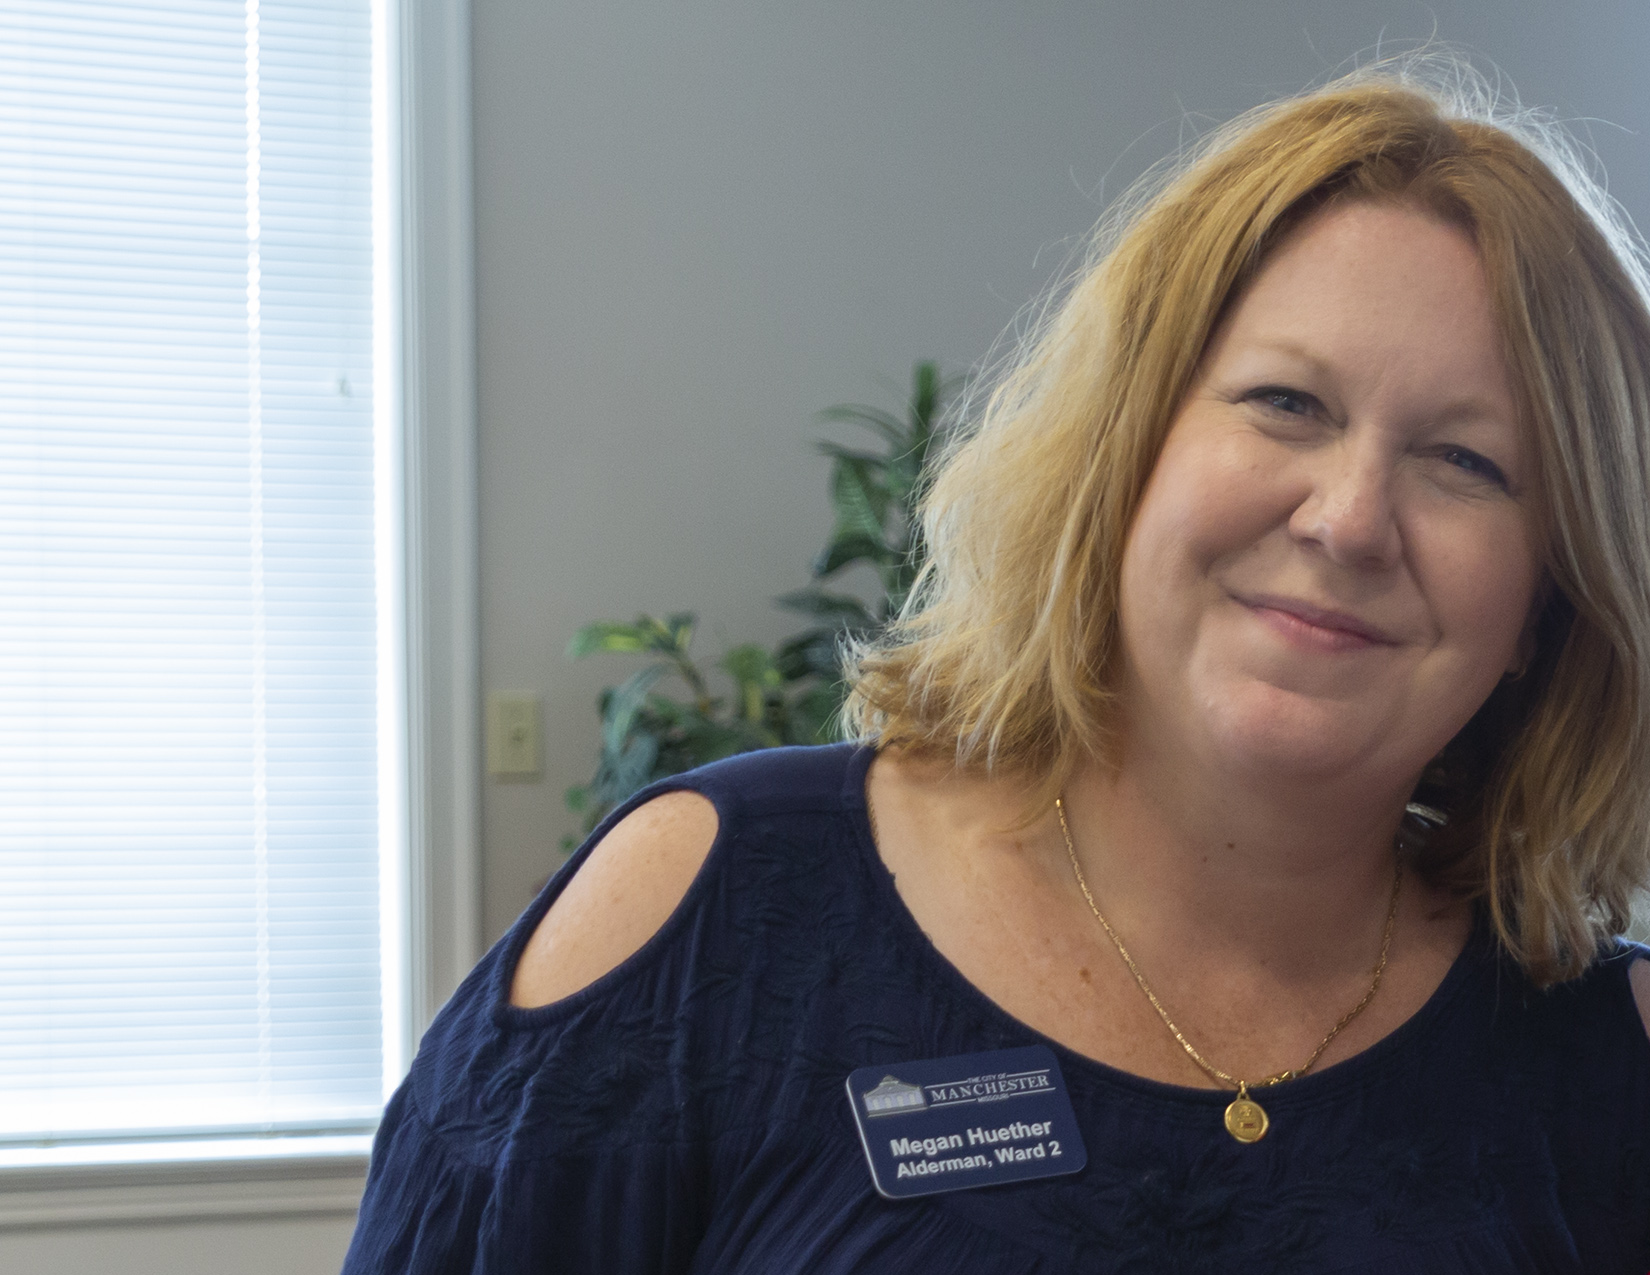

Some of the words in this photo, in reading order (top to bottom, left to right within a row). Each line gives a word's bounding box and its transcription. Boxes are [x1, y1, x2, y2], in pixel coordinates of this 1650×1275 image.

[931, 1075, 1050, 1102] MANCHESTER
[981, 1074, 997, 1082] CITY
[997, 1072, 1007, 1080] OF
[889, 1137, 963, 1157] Megan
[966, 1121, 1052, 1146] Huether
[897, 1154, 993, 1179] Alderman,
[994, 1143, 1046, 1165] Ward
[1048, 1140, 1063, 1157] 2
